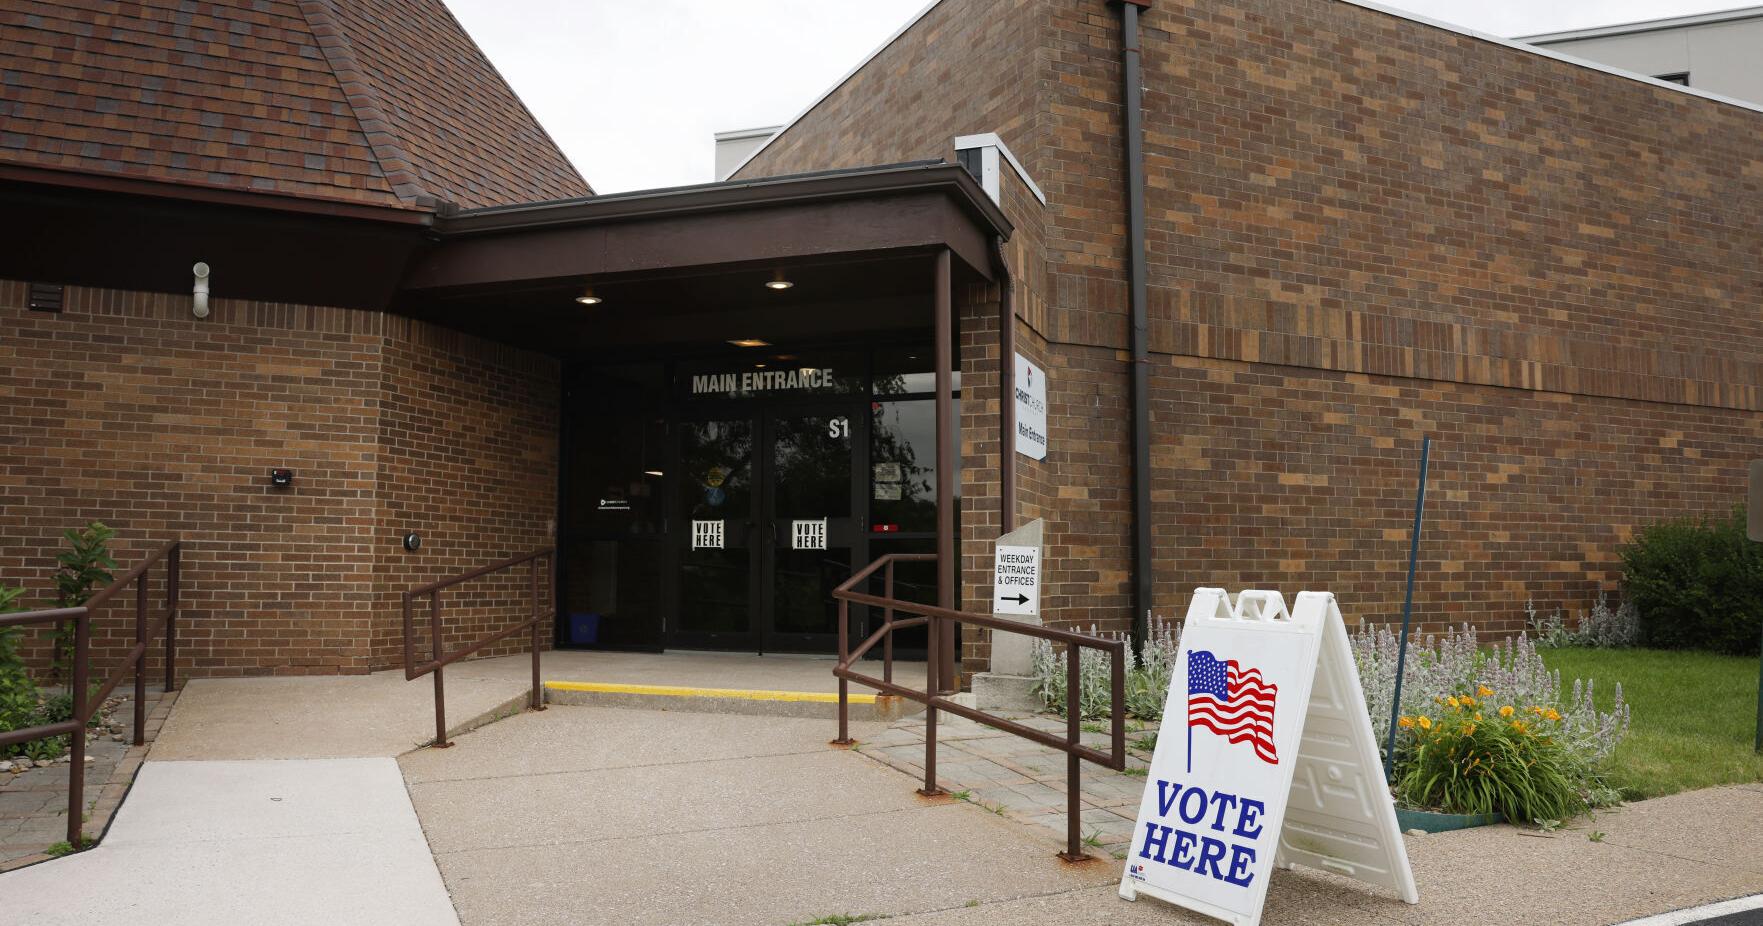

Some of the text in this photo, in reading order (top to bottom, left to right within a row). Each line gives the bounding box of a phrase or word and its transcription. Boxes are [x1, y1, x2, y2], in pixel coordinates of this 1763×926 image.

[692, 368, 833, 394] MAIN ENTRANCE
[829, 418, 849, 439] S1
[1018, 421, 1045, 446] Main Entrance
[696, 523, 722, 535] VOTE
[796, 523, 824, 535] VOTE
[696, 535, 722, 547] HERE
[796, 535, 824, 548] HERE
[1000, 553, 1034, 564] WEEKDAY
[998, 564, 1036, 575] ENTRANCE
[998, 575, 1035, 586] & OFFICES
[1156, 779, 1265, 840] VOTE
[1138, 821, 1256, 888] HERE
